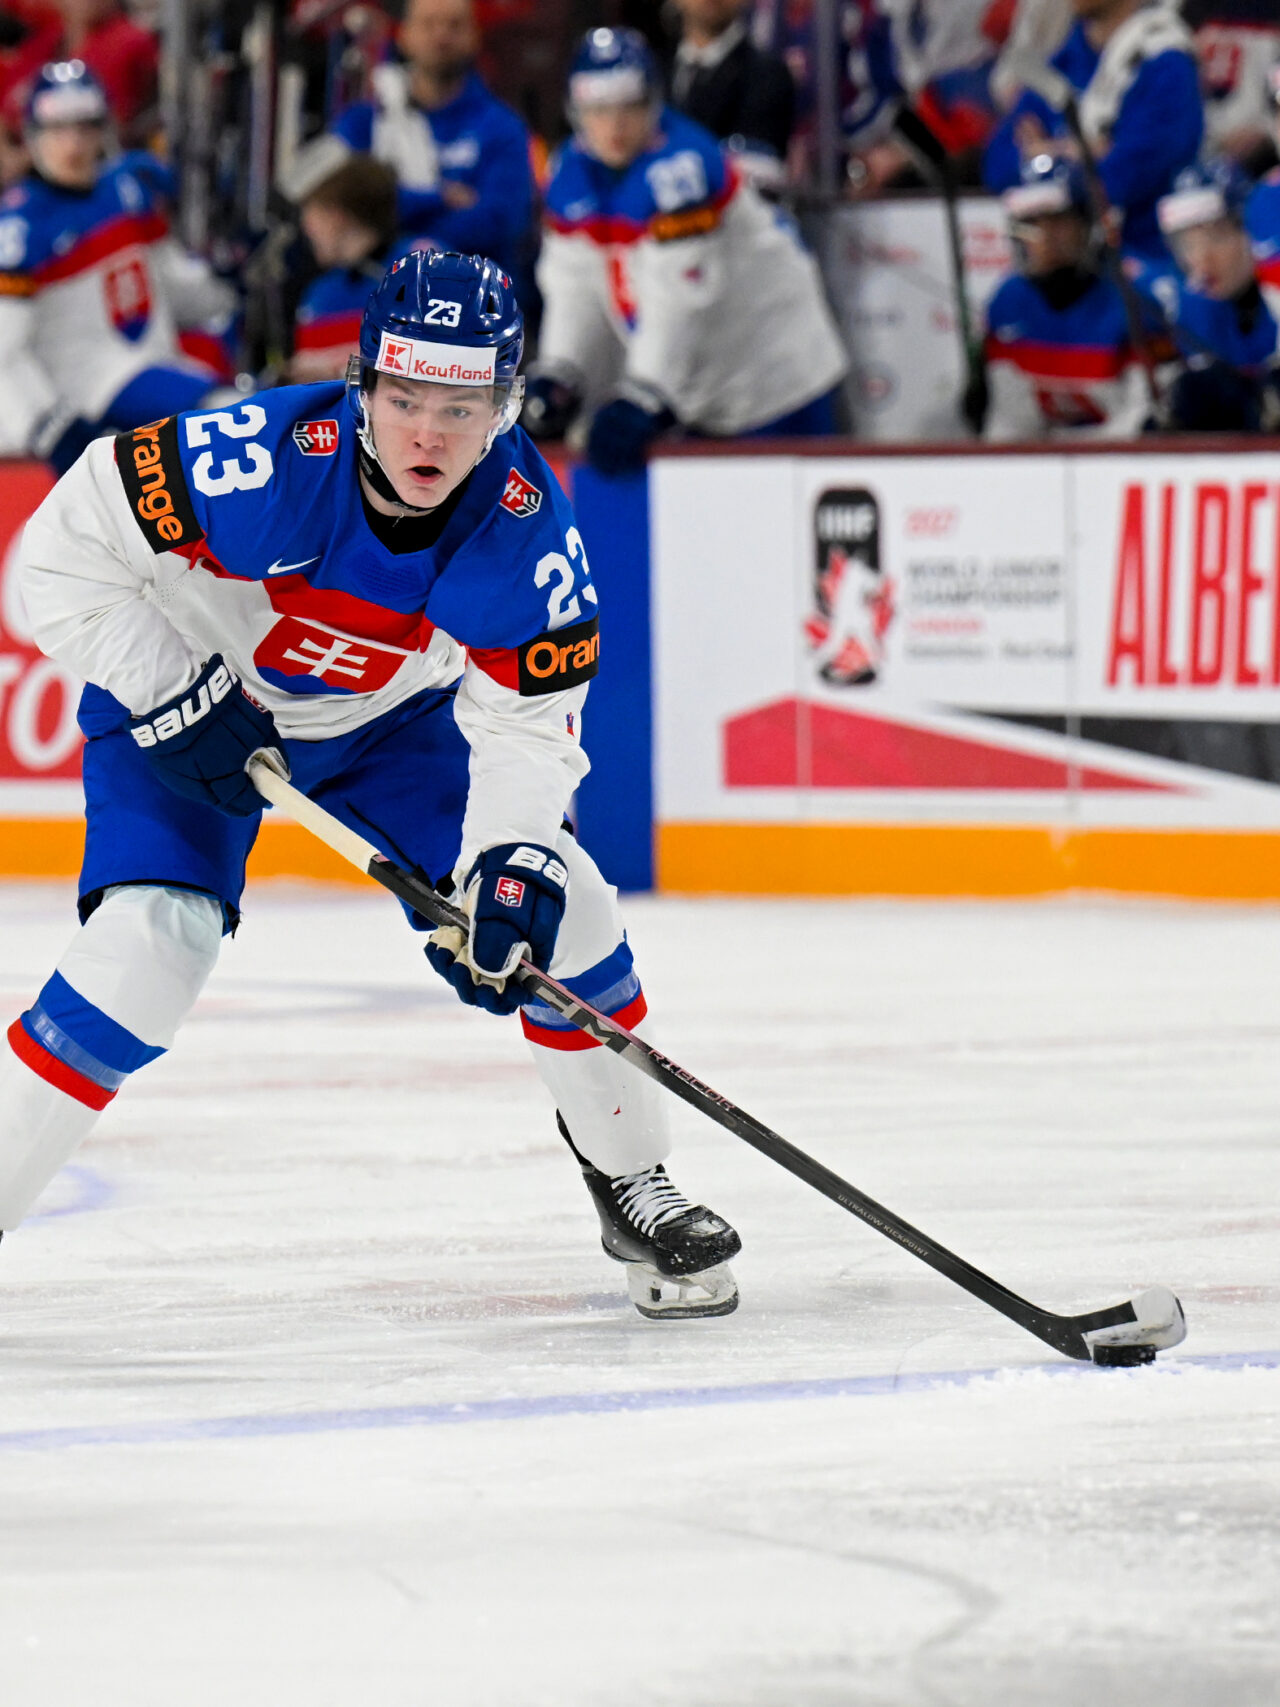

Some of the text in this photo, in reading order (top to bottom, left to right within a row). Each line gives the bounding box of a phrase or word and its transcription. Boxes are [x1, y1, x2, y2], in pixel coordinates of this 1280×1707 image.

[424, 299, 462, 328] 23
[413, 359, 492, 381] Kaufland
[185, 404, 273, 497] 23
[837, 1194, 929, 1257] ULTRALOW KICKPOINT
